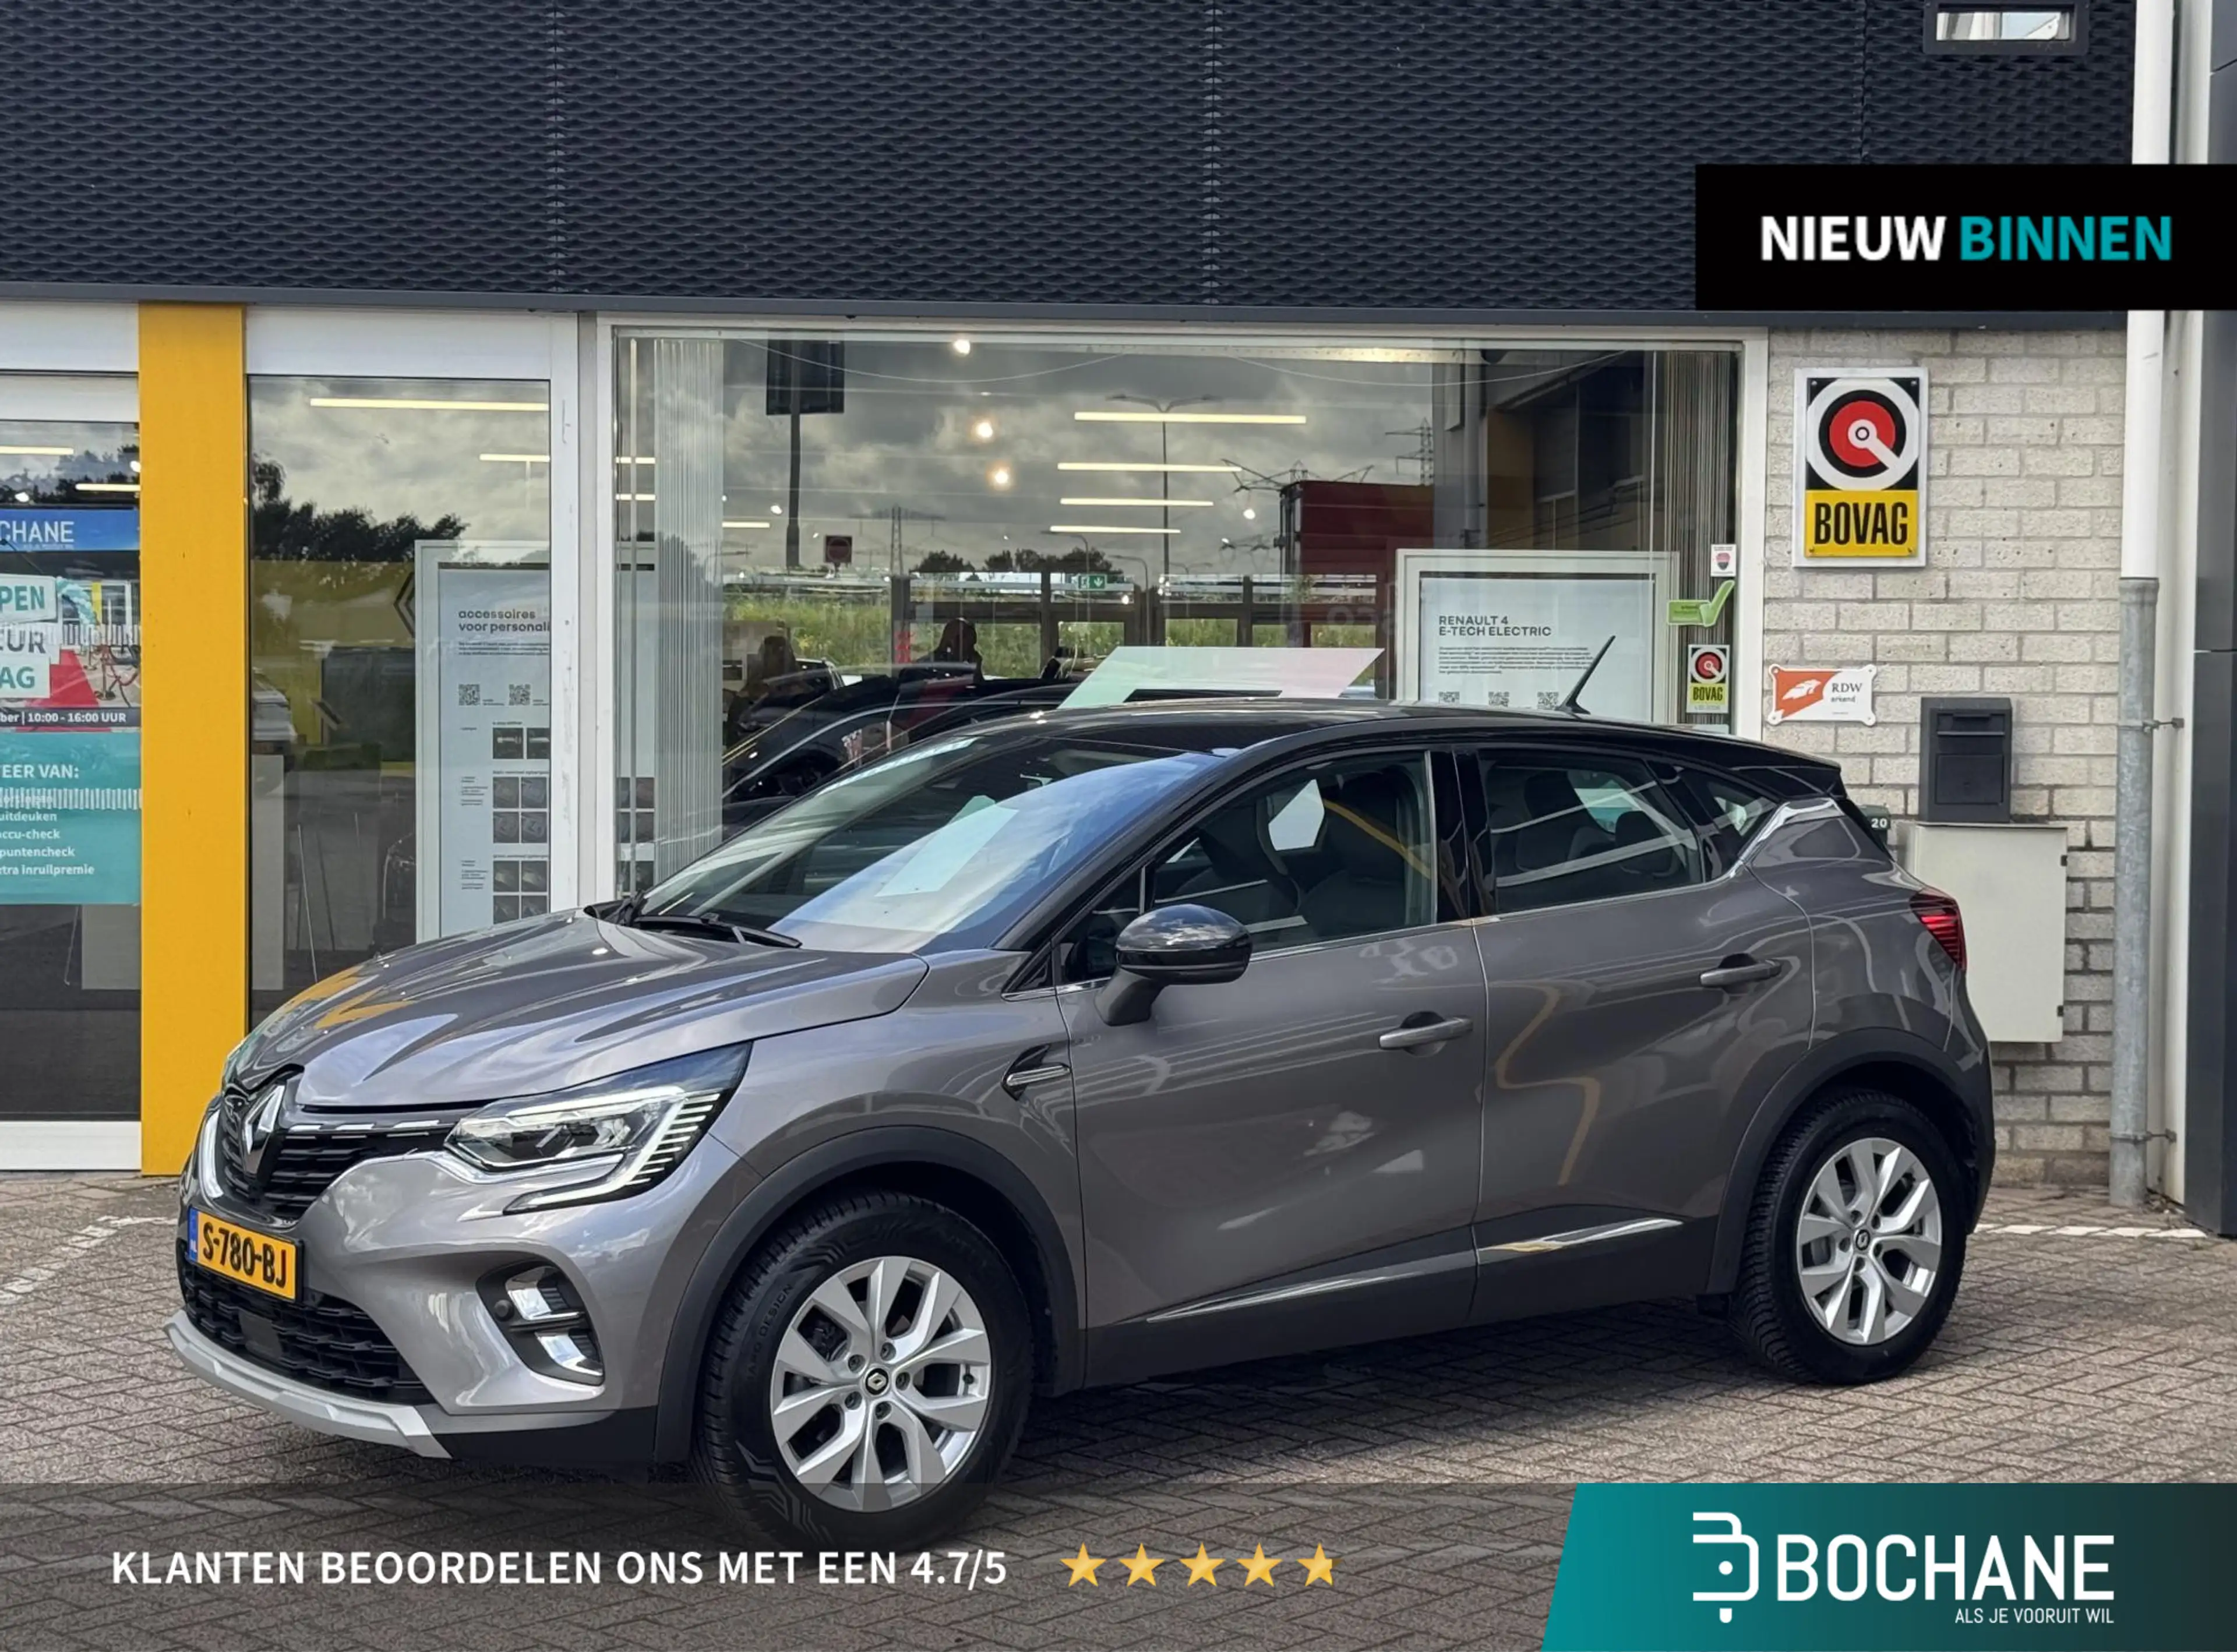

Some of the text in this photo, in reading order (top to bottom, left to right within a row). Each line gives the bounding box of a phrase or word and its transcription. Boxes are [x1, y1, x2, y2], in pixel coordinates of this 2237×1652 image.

[1815, 502, 1908, 545] BOVAG
[0, 520, 75, 542] CHANE
[0, 585, 45, 611] PEN
[458, 609, 536, 619] accessoires
[1439, 615, 1508, 625] RENAULT 4
[458, 623, 488, 631] voor
[1439, 626, 1552, 636] E-TECH ELECTRIC
[0, 629, 46, 654] UR
[0, 666, 35, 689] AG
[1693, 686, 1723, 701] BOVAG
[1832, 682, 1862, 693] RDW
[29, 712, 59, 722] 10:00
[68, 712, 99, 722] 16:00
[101, 712, 126, 722] UUR
[0, 764, 79, 779] EER VAN:
[1871, 818, 1887, 828] 20
[0, 846, 76, 860] puntencheck
[21, 864, 95, 877] inruilpremie
[203, 1222, 287, 1289] S-780-BJ
